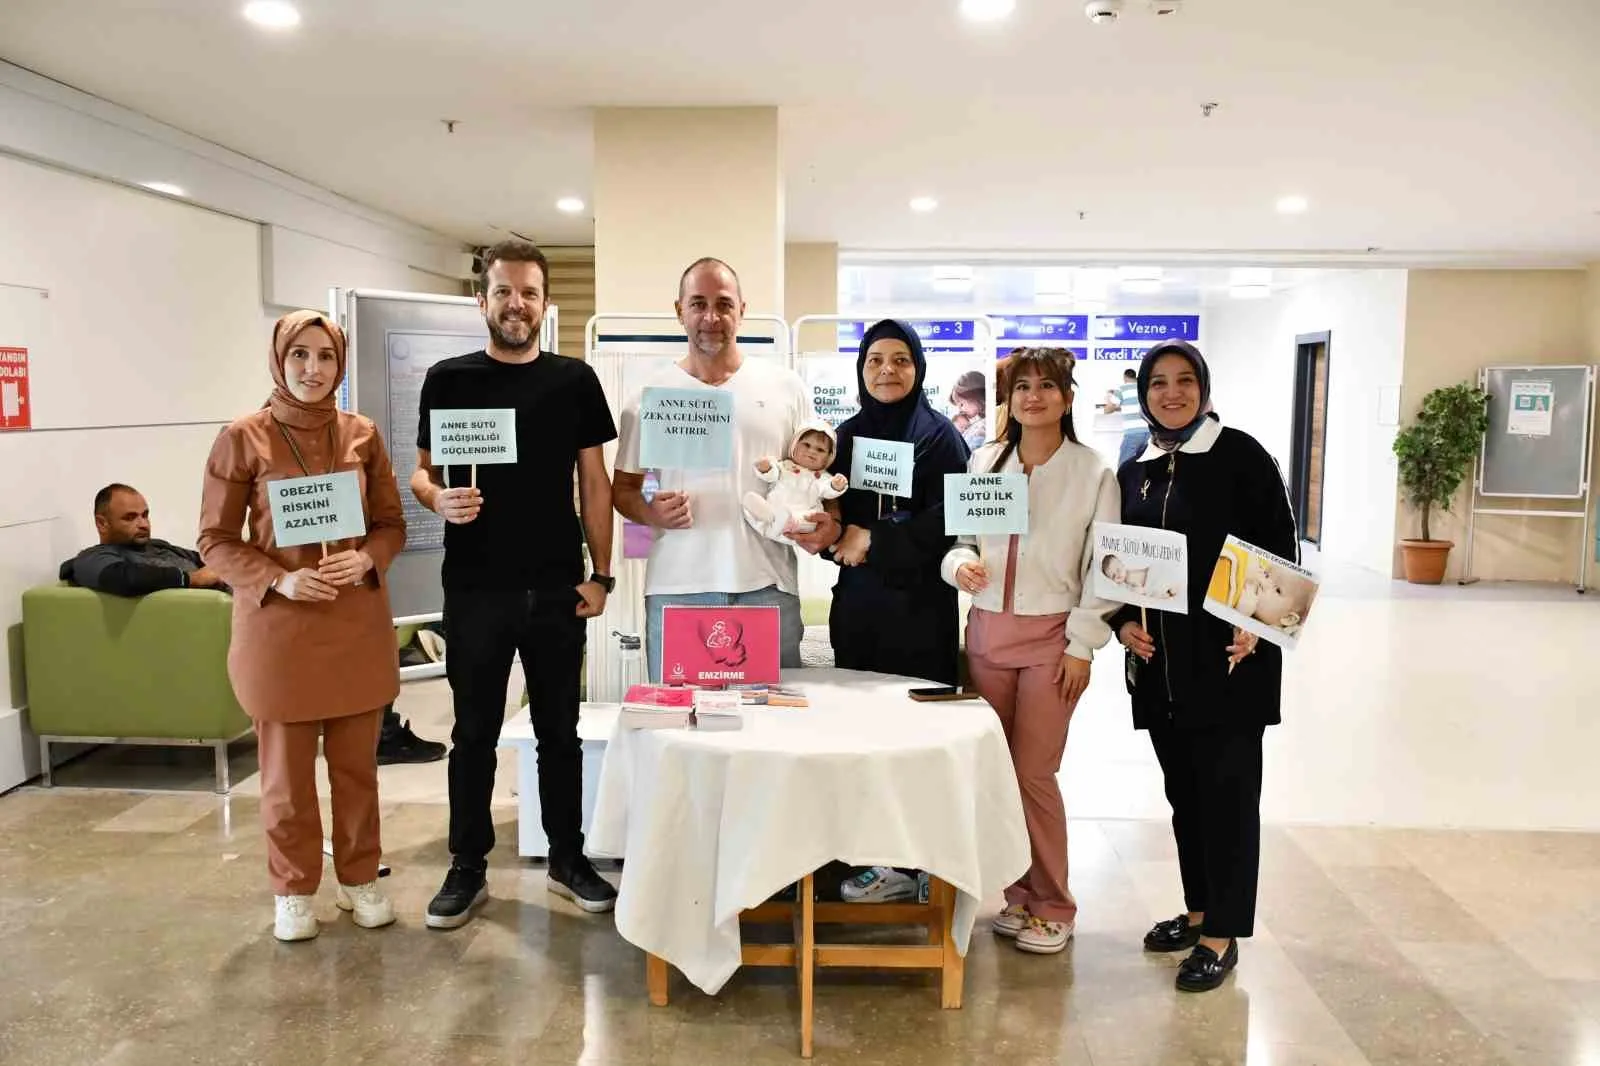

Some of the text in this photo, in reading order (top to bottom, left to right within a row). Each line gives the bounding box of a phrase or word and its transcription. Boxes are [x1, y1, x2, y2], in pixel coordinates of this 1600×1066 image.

[954, 322, 963, 334] 3
[1067, 321, 1076, 334] 2
[1128, 321, 1167, 334] Vezne
[1182, 321, 1187, 334] 1
[1096, 348, 1128, 360] Kredi
[659, 399, 686, 408] ANNE
[813, 397, 840, 405] Olan
[643, 411, 671, 421] ZEKA
[441, 420, 496, 429] ANNE SÜTÜ
[441, 433, 500, 442] BAĞIŞIKLIĞI
[441, 445, 507, 455] GÜÇLENDİRİR
[866, 450, 897, 461] ALERJİ
[865, 463, 897, 476] RİSKİNİ
[862, 479, 899, 491] AZALTIR
[970, 477, 1002, 485] ANNE
[280, 482, 334, 497] OBEZİTE
[960, 490, 1014, 501] SÜTÜ İLK
[282, 497, 330, 513] RİSKİNİ
[967, 507, 1006, 517] AŞIDIR
[285, 514, 338, 529] AZALTIR
[698, 670, 745, 680] EMZİRME
